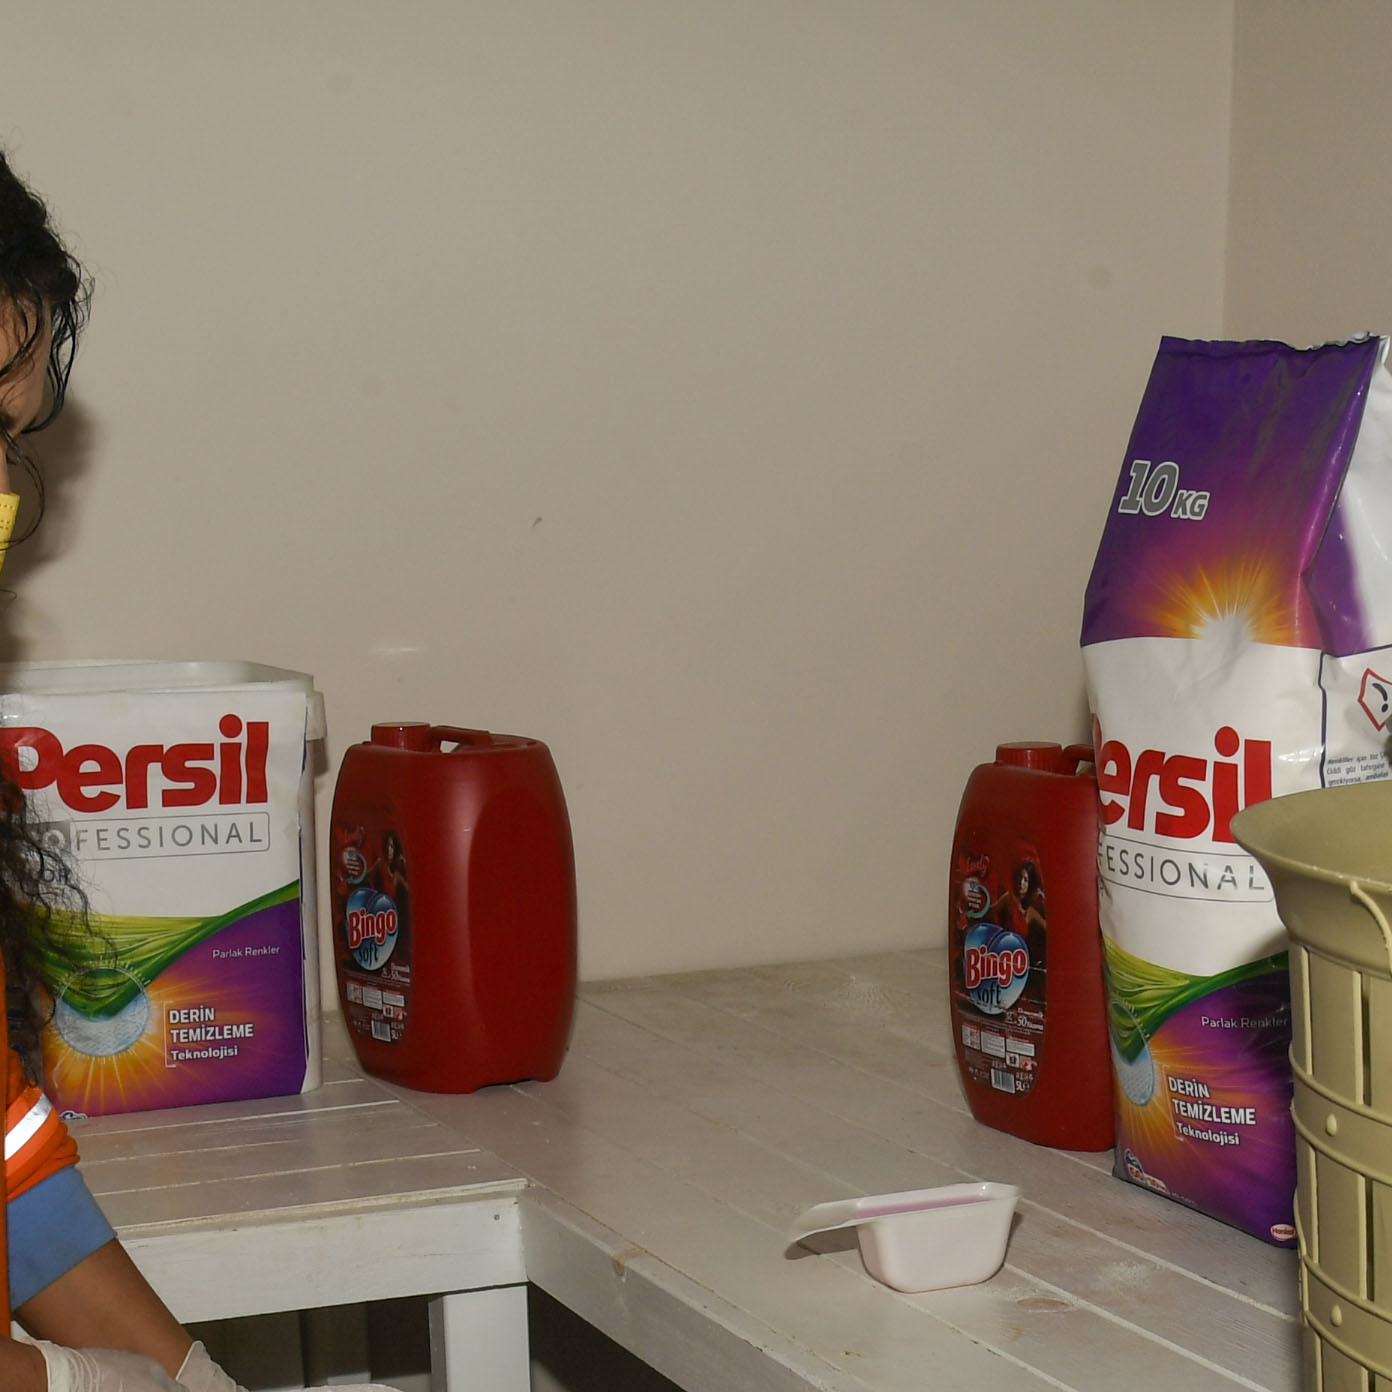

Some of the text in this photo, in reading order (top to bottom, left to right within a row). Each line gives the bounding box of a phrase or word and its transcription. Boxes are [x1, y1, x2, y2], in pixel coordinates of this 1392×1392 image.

[1092, 713, 1273, 843] ersil
[349, 906, 398, 949] Bingo
[212, 945, 281, 959] Parlak Renkler
[966, 944, 1029, 989] Bingo
[169, 1004, 215, 1024] DERİN
[1201, 1016, 1287, 1029] Parlak Renkler
[170, 1023, 254, 1043] TEMİZLEME
[171, 1045, 238, 1060] Teknolojisi
[1168, 1076, 1211, 1098] DERİN
[1172, 1098, 1256, 1125] TEMİZLEME
[1176, 1122, 1240, 1146] Teknolojisi
